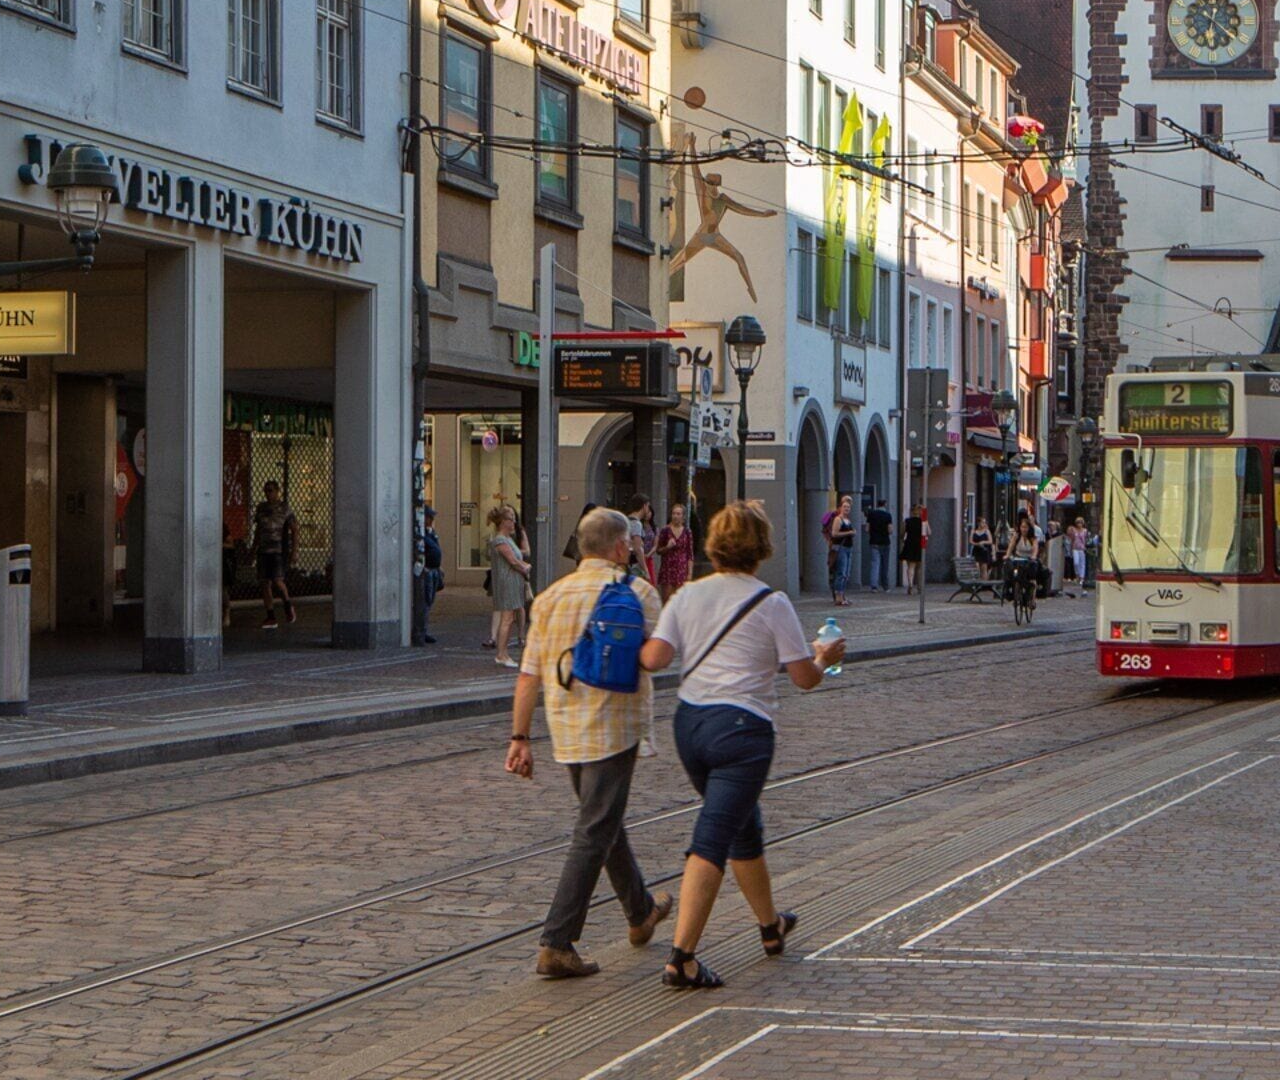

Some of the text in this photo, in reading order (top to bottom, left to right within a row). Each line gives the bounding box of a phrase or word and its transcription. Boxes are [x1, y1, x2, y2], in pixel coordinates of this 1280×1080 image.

[569, 18, 640, 94] LEIPZIGER
[24, 133, 365, 263] JWELIER KÜHN
[1171, 385, 1184, 403] 2
[1157, 589, 1183, 600] VAG
[1120, 654, 1152, 669] 263
